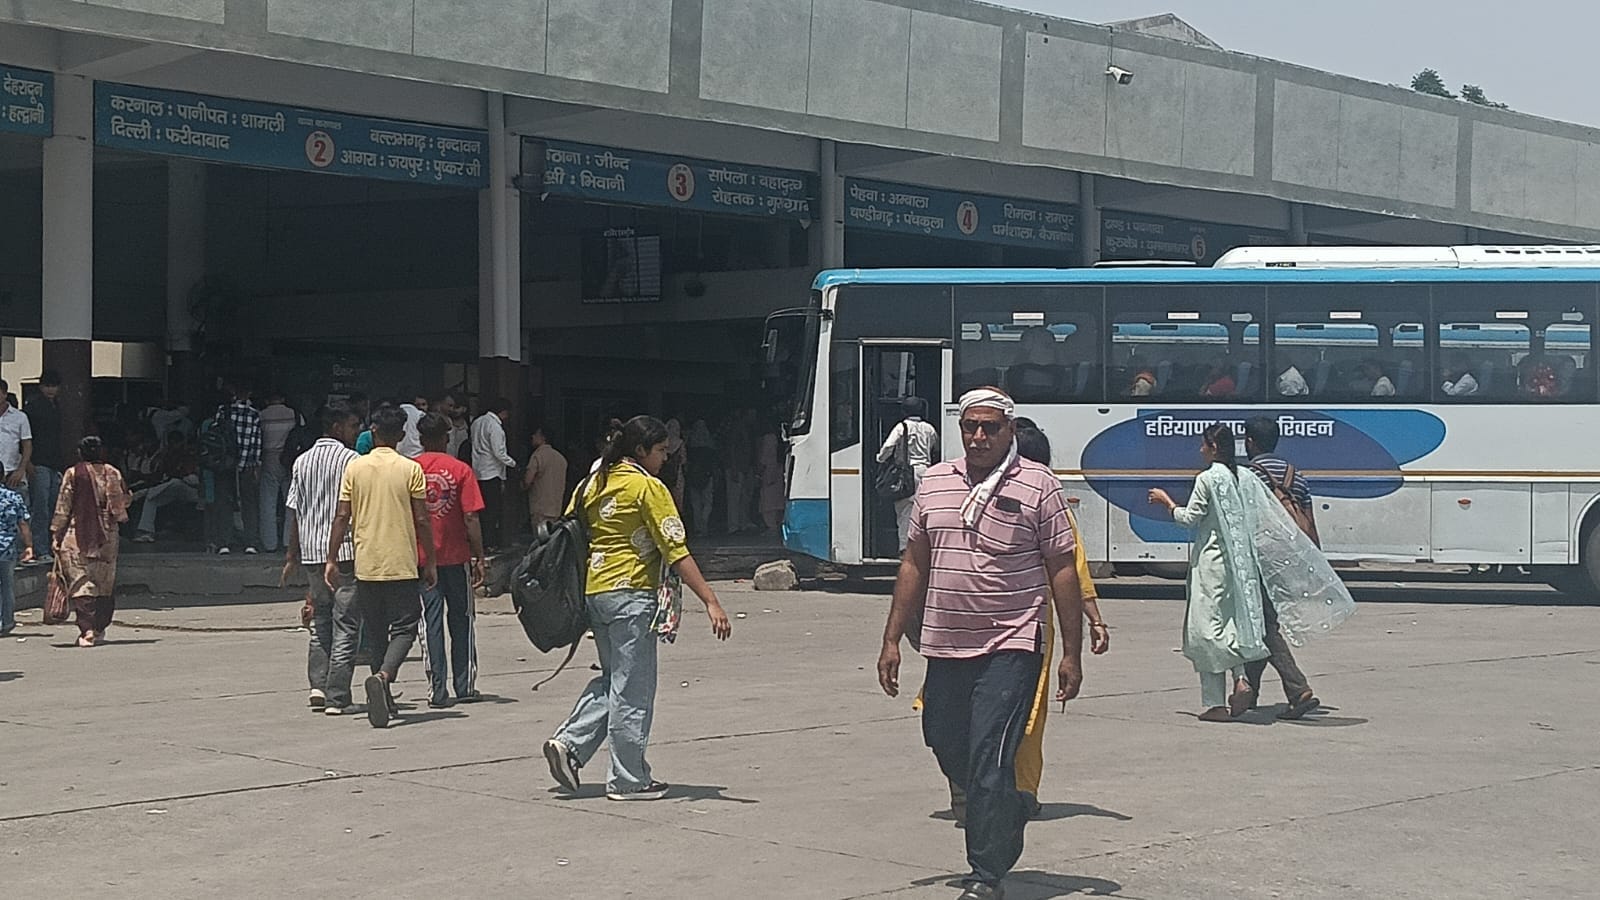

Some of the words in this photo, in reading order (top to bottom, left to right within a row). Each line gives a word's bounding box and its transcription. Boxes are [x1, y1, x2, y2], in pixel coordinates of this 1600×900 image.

[3, 72, 44, 104] देहरादून
[111, 95, 164, 116] करनाल
[177, 102, 228, 125] पानीपत
[241, 112, 286, 133] शामली
[111, 116, 152, 140] दिल्ली
[165, 125, 231, 149] फरीदाबाद
[314, 140, 326, 162] 2
[437, 137, 481, 157] वृन्दावन
[341, 150, 377, 166] आगरा
[388, 155, 425, 177] जयपुर
[594, 151, 631, 170] जीन्द
[580, 170, 625, 191] भिवानी
[675, 173, 687, 196] 3
[712, 187, 755, 205] रोहतक
[962, 209, 972, 230] 4
[1003, 203, 1036, 221] शिमला
[1144, 415, 1217, 436] हरियाण
[1276, 415, 1335, 437] रिवहन
